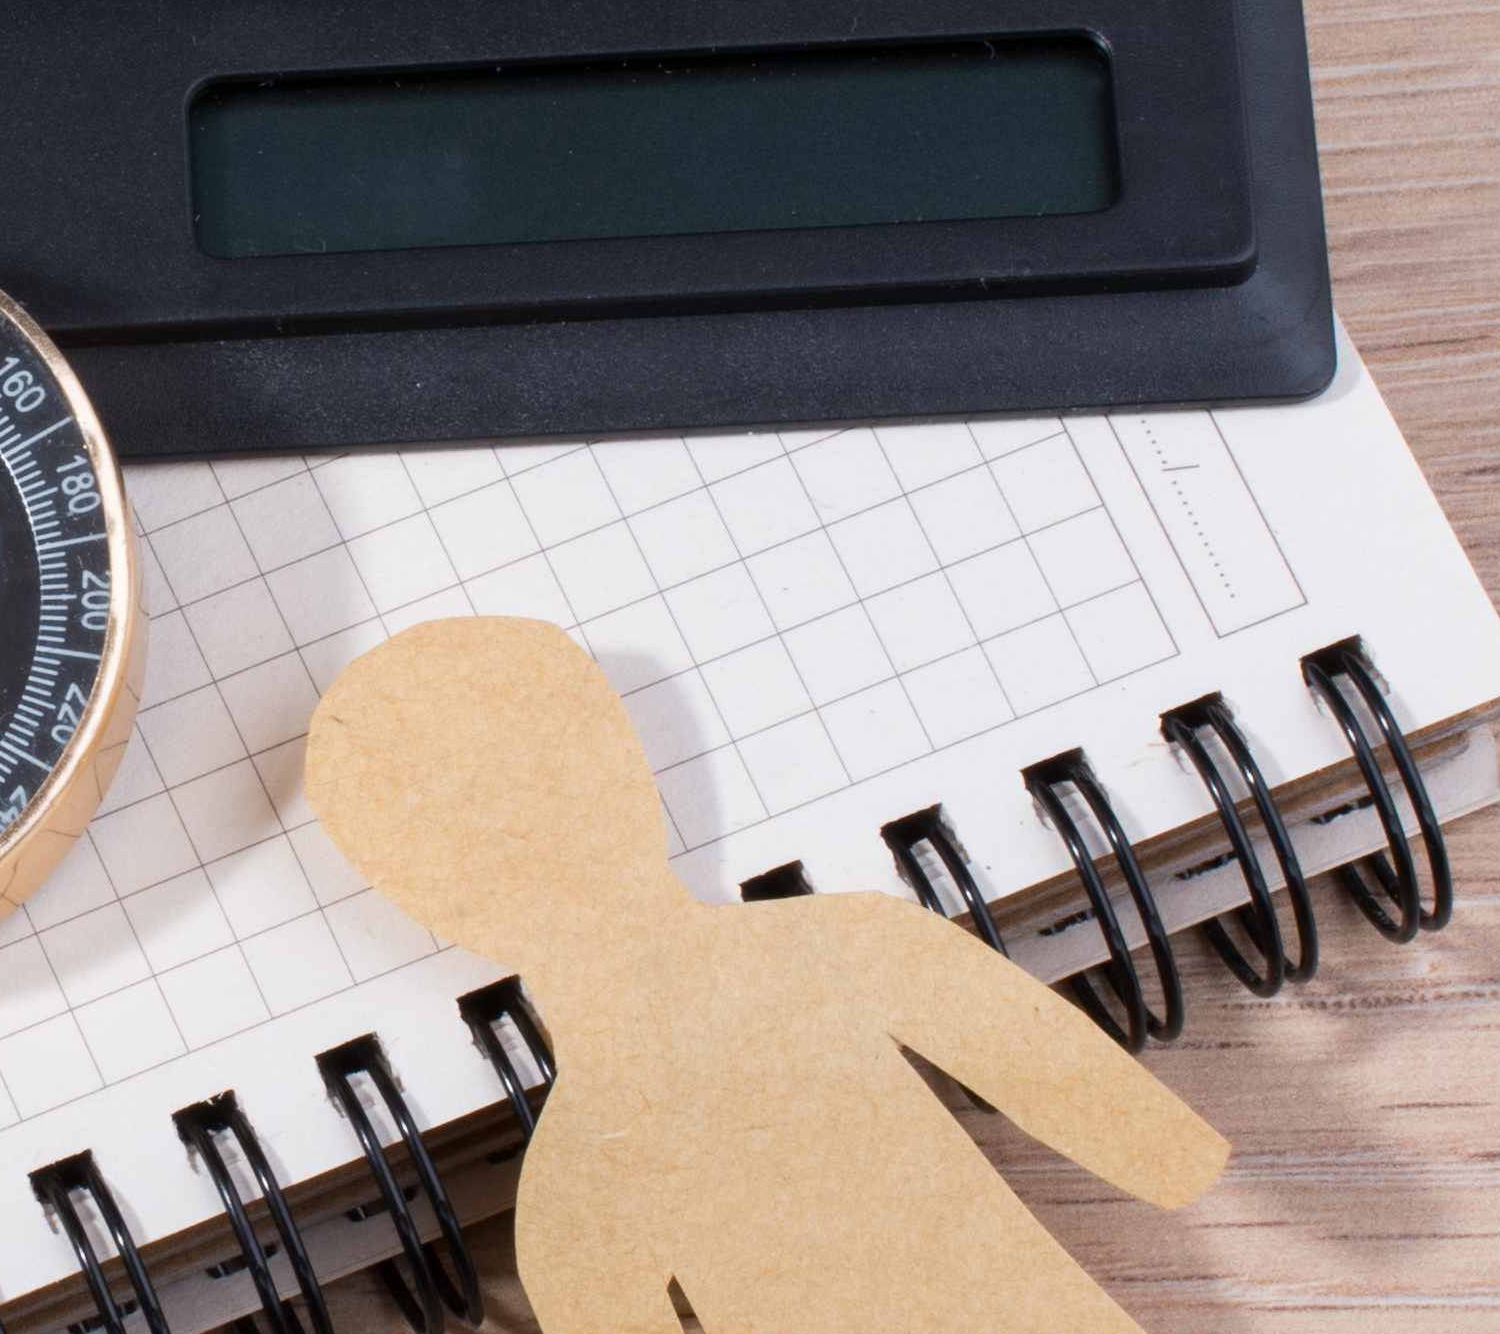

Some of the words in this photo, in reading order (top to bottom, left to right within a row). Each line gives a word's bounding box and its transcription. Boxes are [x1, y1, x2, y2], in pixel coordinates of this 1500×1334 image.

[55, 454, 101, 515] 180
[80, 569, 111, 631] 200
[50, 681, 86, 745] 220
